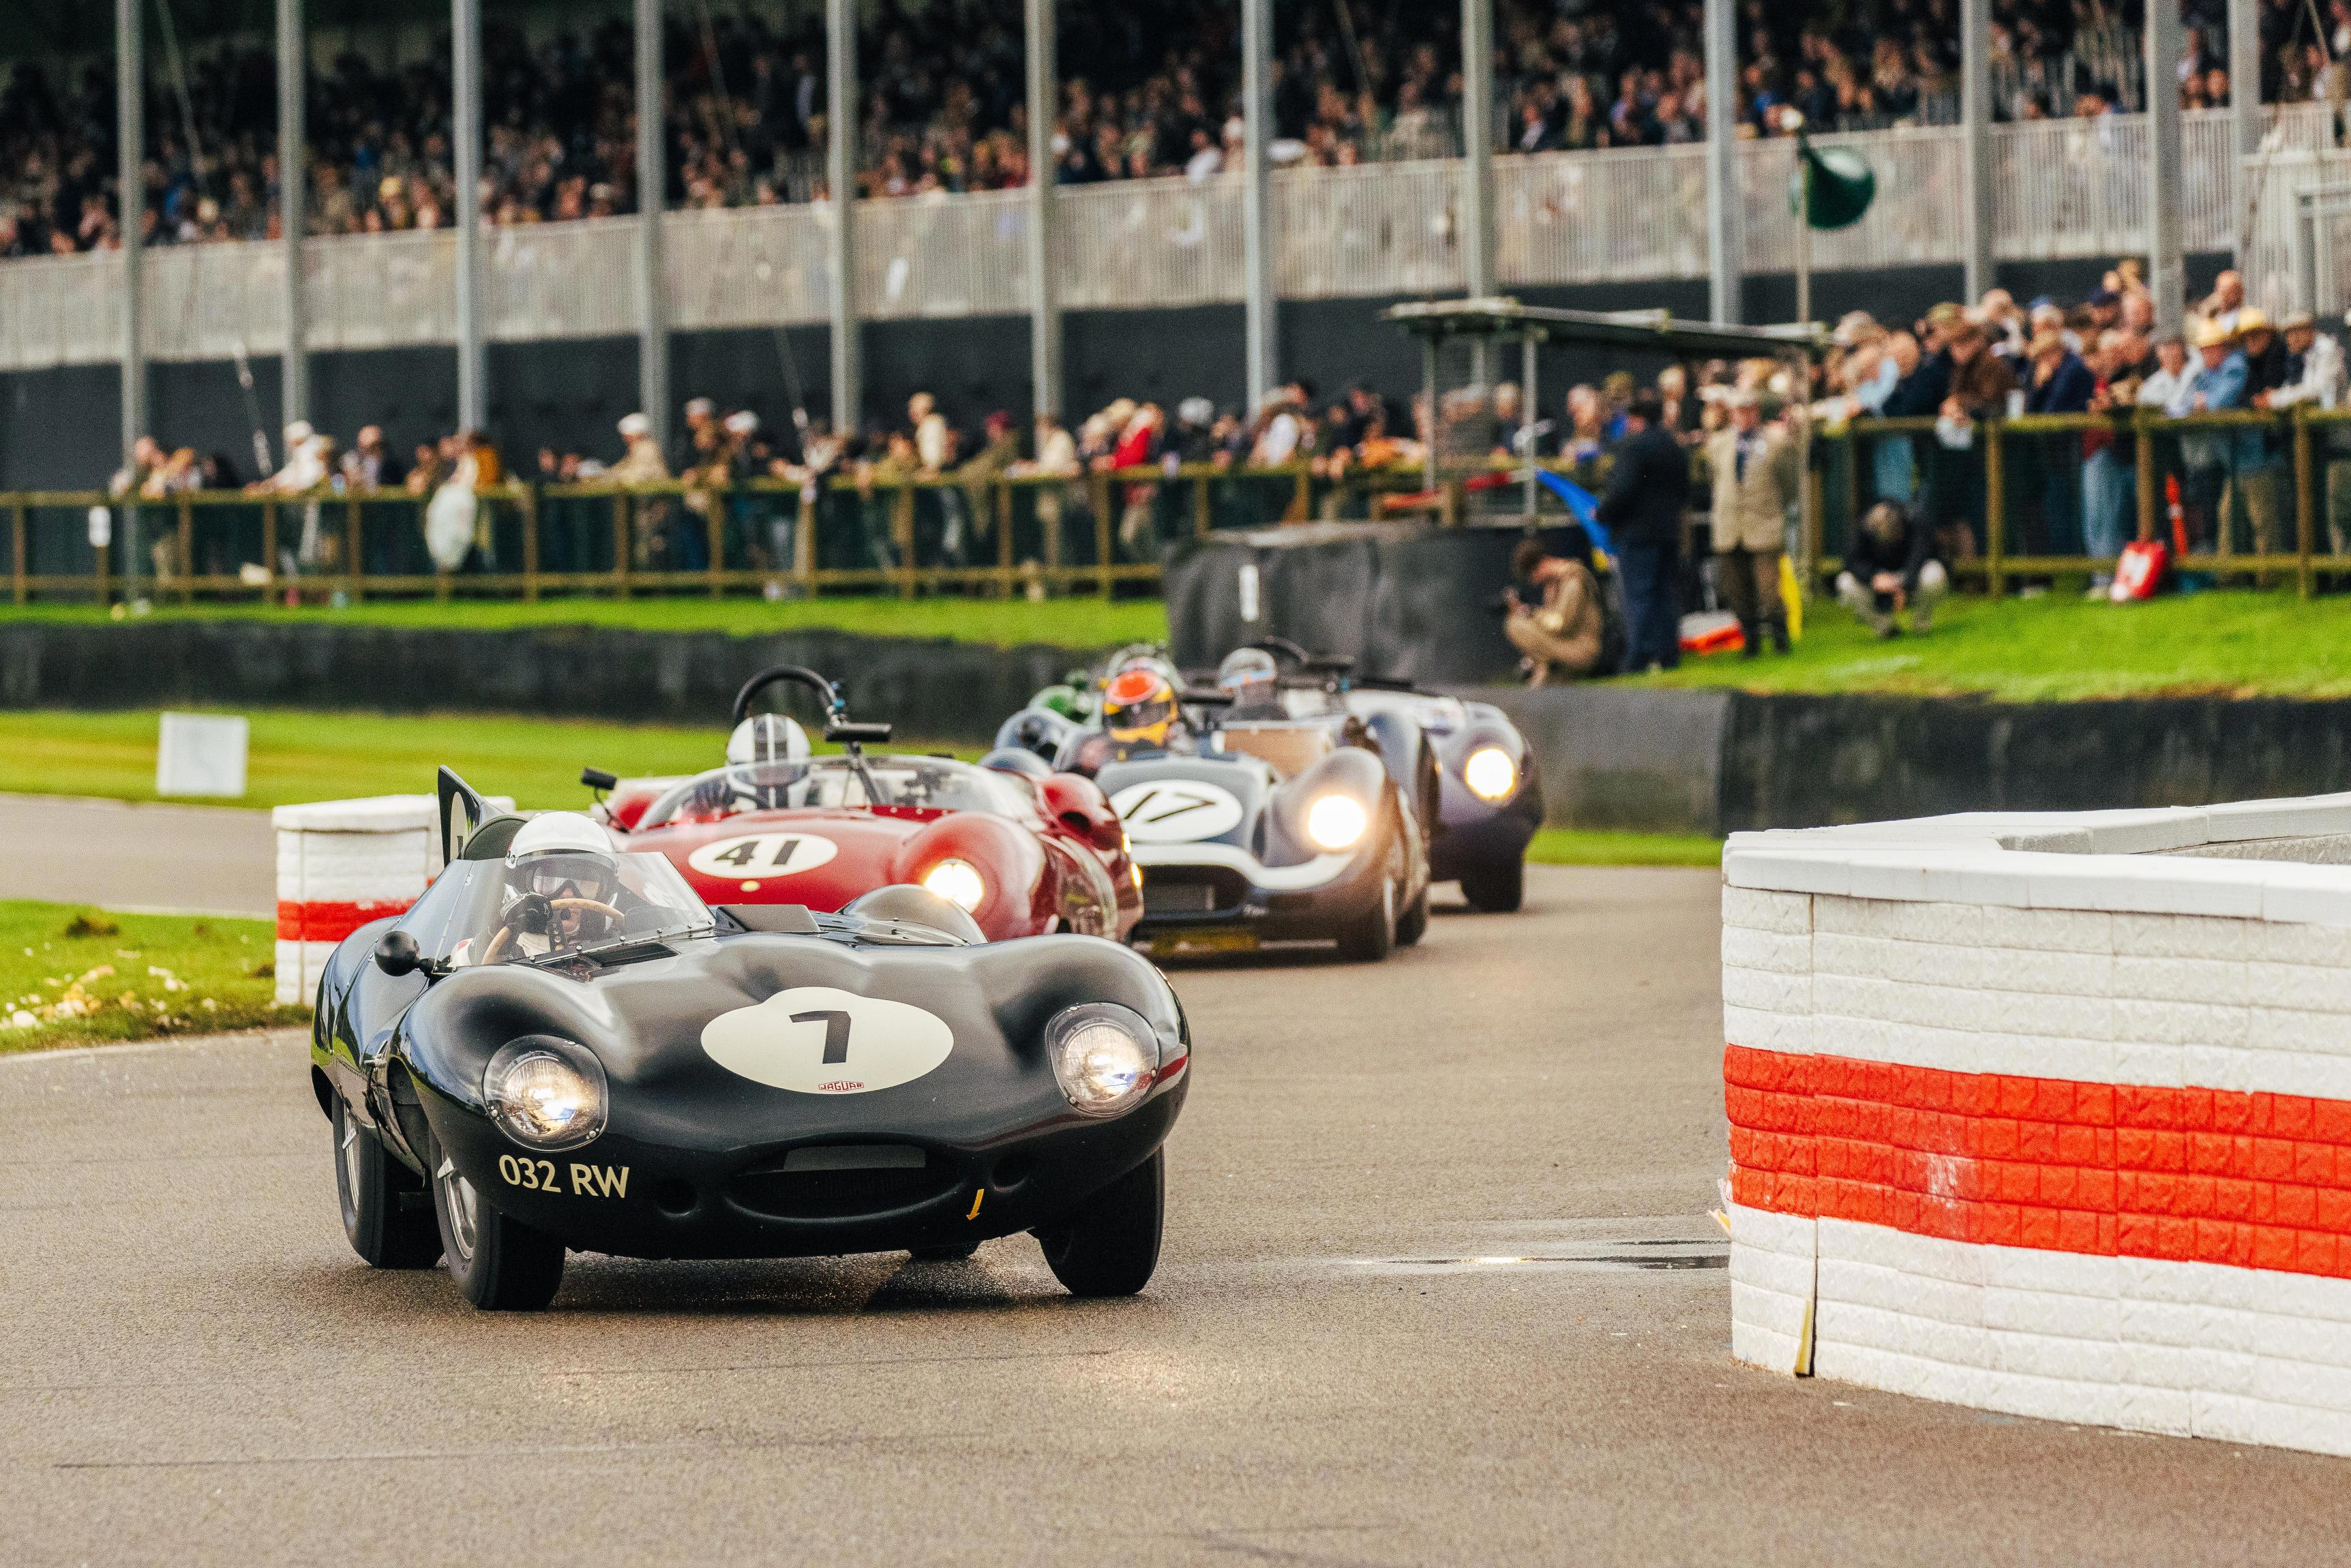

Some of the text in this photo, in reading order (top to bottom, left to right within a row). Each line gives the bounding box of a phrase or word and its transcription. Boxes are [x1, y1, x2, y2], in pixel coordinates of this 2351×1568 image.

[1124, 790, 1217, 824] 17
[713, 840, 799, 866] 41
[789, 1010, 851, 1064] 7
[820, 1081, 863, 1091] JAGUAR
[570, 1163, 629, 1198] RW
